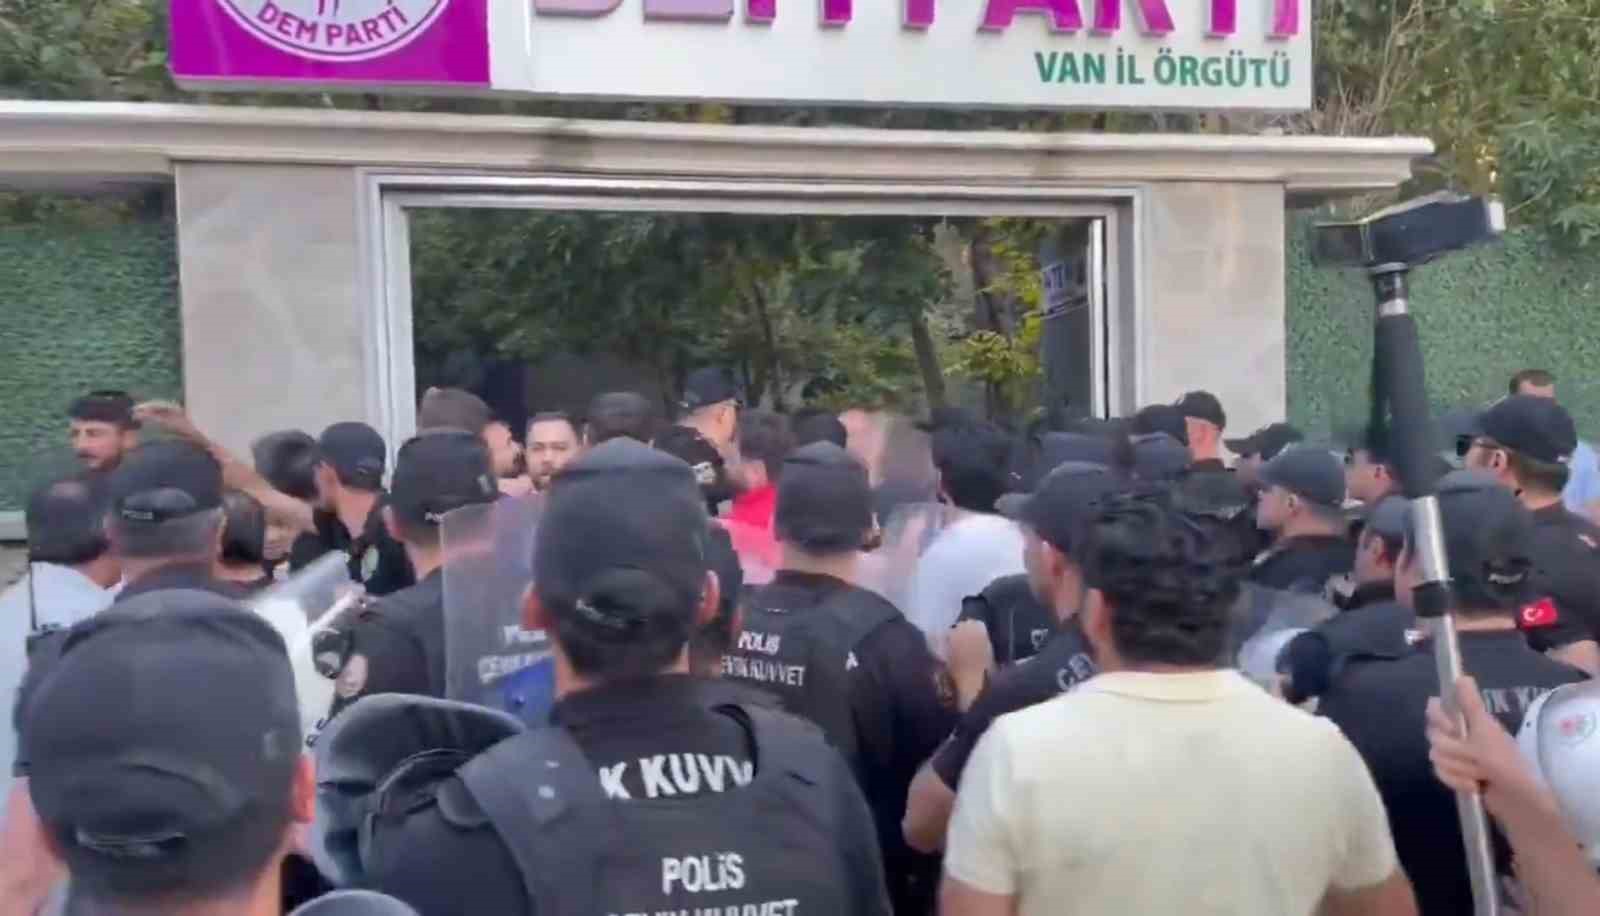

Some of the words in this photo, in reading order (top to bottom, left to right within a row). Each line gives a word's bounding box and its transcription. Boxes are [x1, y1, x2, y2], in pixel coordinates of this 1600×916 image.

[257, 1, 318, 43] DEM
[1034, 51, 1106, 84] VAN
[1115, 47, 1145, 85] İL
[1153, 47, 1291, 88] ÖRGÜTÜ
[639, 752, 753, 798] KUVV
